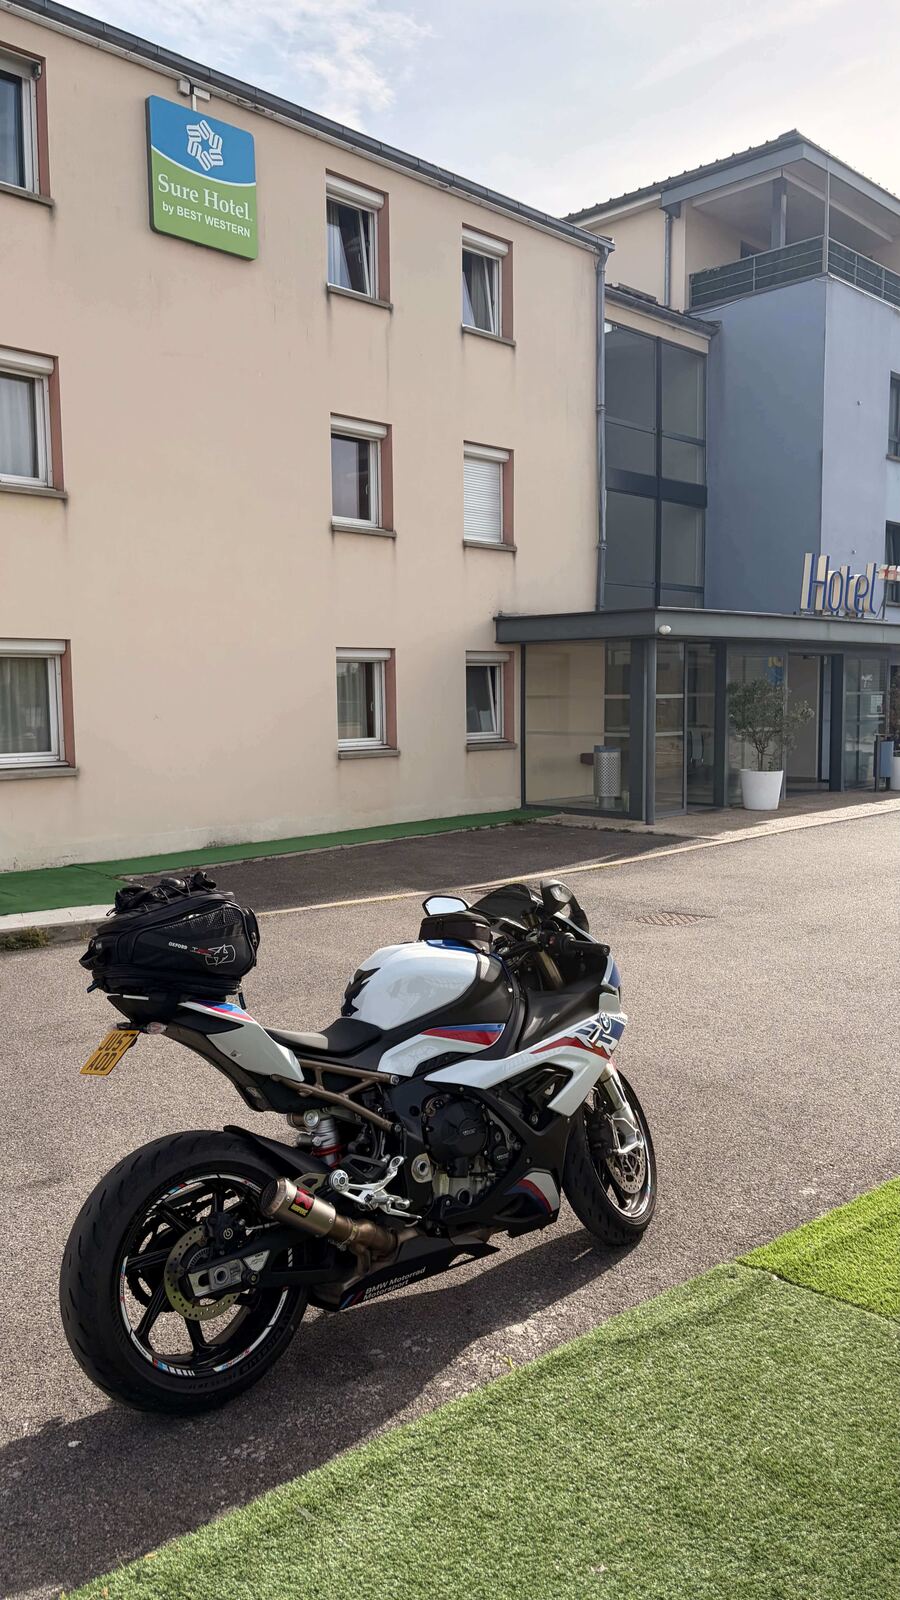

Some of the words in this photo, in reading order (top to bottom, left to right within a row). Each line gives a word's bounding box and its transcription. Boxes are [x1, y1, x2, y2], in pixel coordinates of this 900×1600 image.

[158, 173, 199, 203] Sure
[203, 188, 252, 220] Hotel
[162, 201, 174, 215] by
[177, 205, 202, 222] BEST
[204, 214, 250, 238] WESTERN
[800, 552, 877, 614] Hotel
[168, 941, 188, 950] OXFORD
[363, 1280, 409, 1300] Motorsport
[365, 1281, 389, 1294] BMW
[389, 1266, 426, 1285] Motorrad
